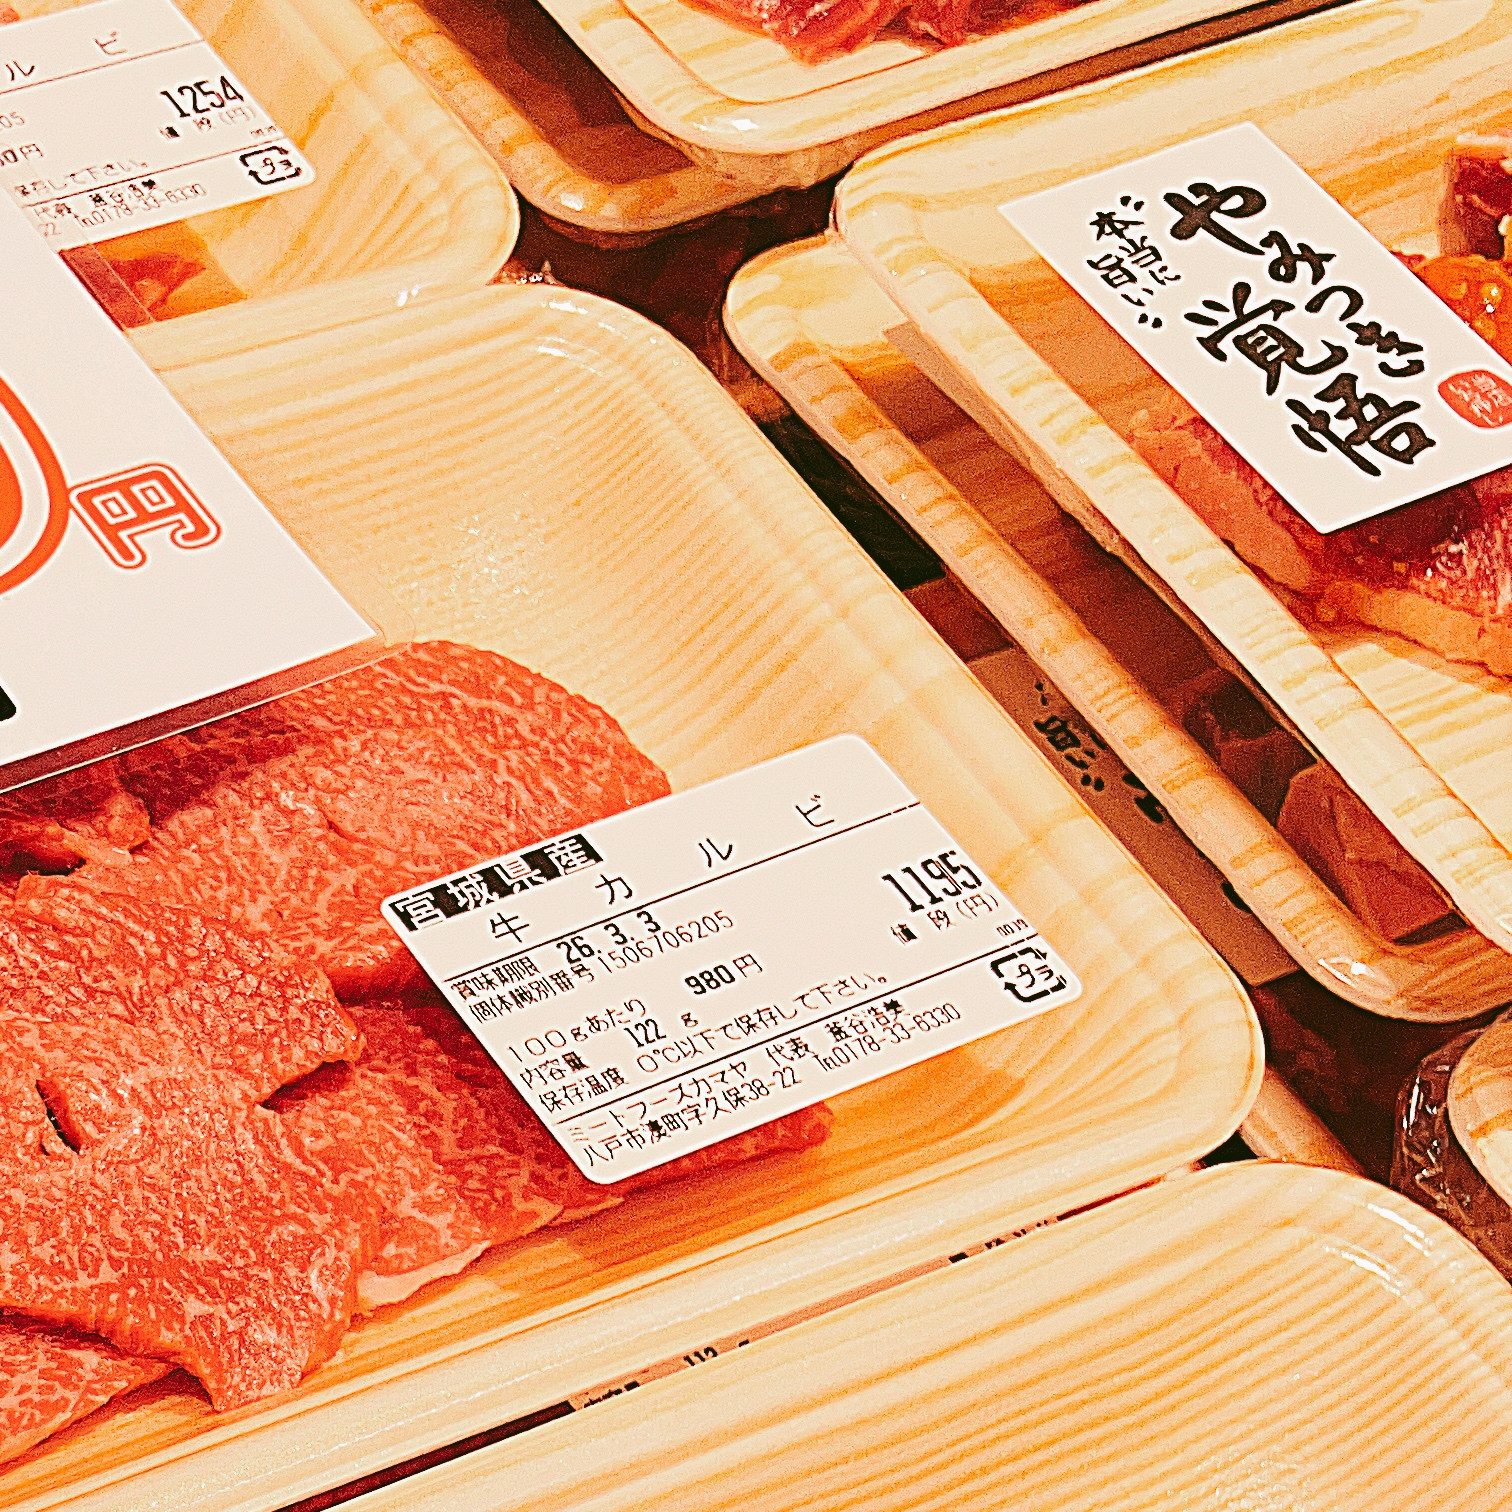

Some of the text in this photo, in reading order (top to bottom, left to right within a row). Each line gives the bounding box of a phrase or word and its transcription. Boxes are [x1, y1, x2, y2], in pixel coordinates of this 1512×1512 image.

[160, 75, 244, 118] 1254
[1163, 182, 1424, 377] やみつき
[1185, 282, 1436, 476] 覚悟
[390, 834, 601, 931] 宮城県産
[881, 850, 983, 912] 1195
[451, 955, 541, 1001] 賞味期限
[468, 909, 734, 1025] 個体識別番号 1506706205
[506, 998, 647, 1063] 100gあたり
[519, 1011, 700, 1090] 内容量 122 g
[538, 1066, 630, 1114] 保存温度
